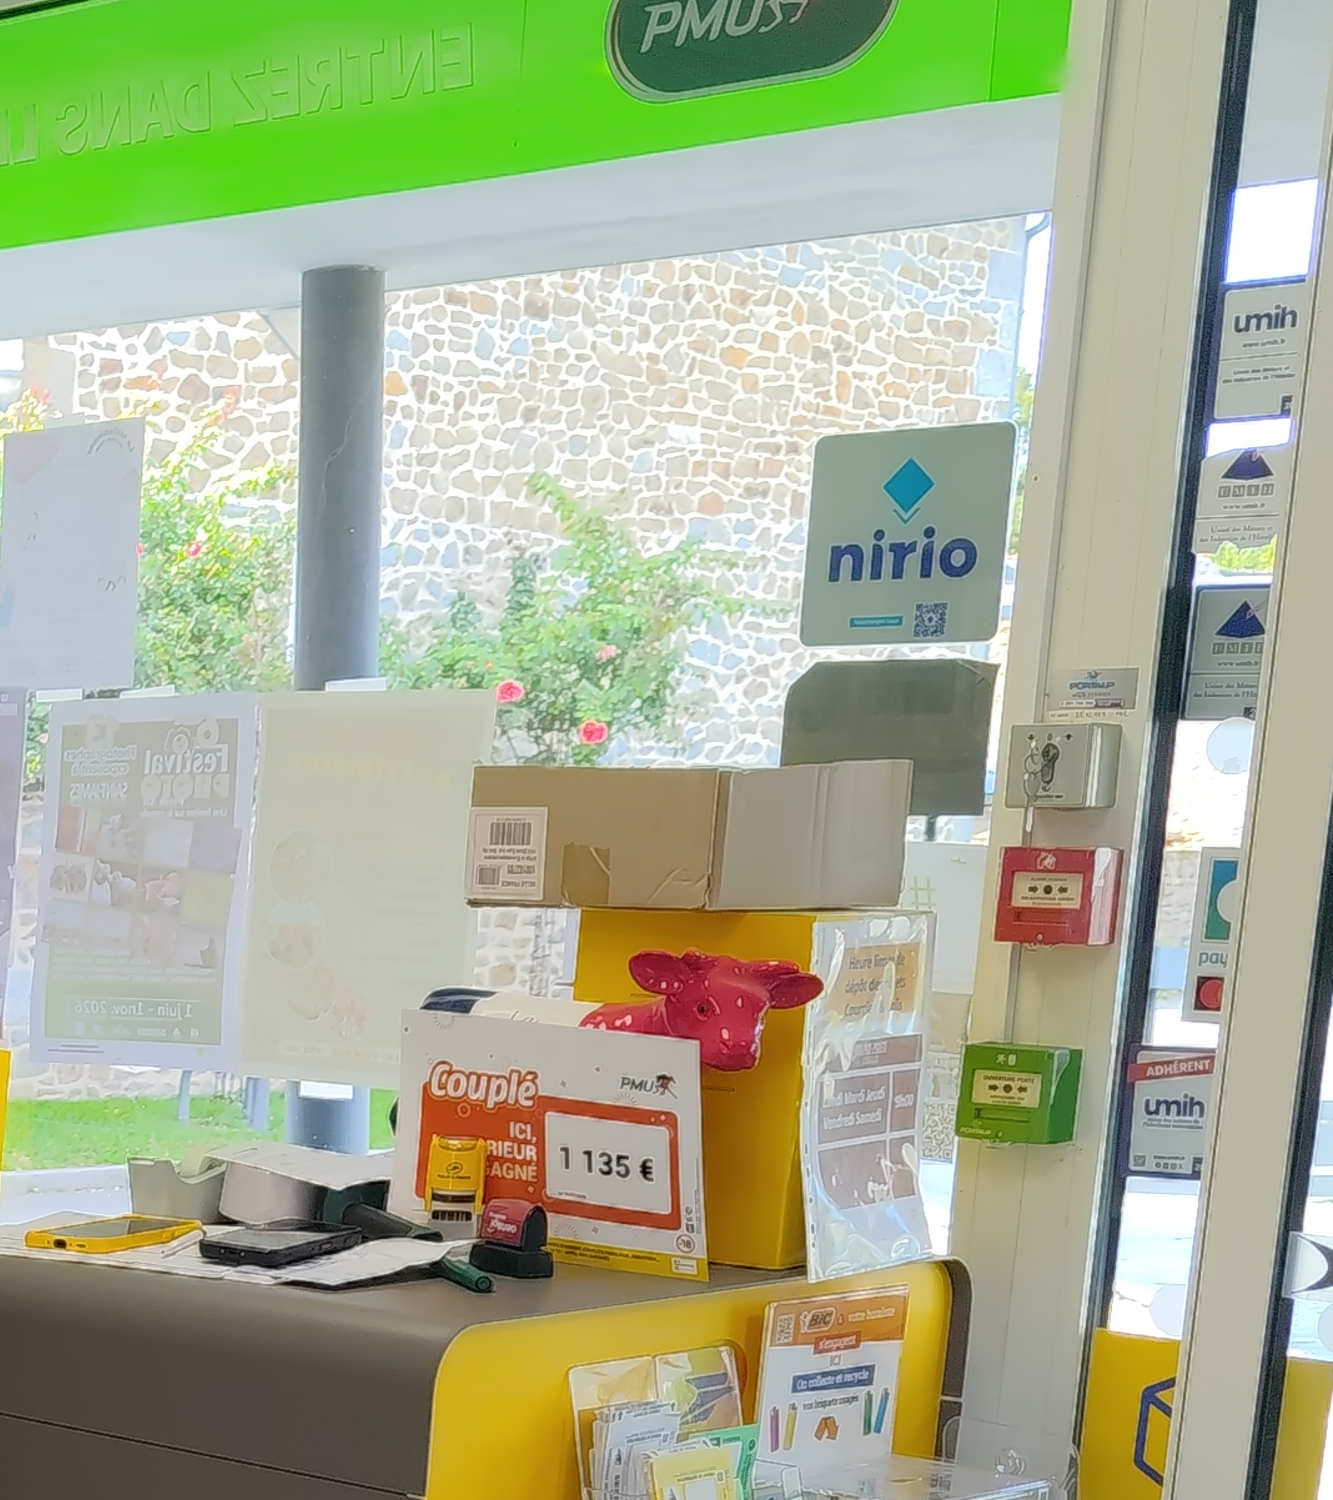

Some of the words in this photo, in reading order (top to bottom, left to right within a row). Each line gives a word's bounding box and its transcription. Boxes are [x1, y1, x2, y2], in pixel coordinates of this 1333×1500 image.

[640, 0, 764, 54] PMU
[1233, 303, 1299, 334] umih
[827, 527, 978, 584] nirio
[848, 957, 872, 970] Heure
[1197, 951, 1228, 968] pay
[844, 981, 867, 996] dépôt
[1145, 1058, 1212, 1077] ADHÉRENT
[430, 1063, 539, 1109] Couplé
[619, 1075, 653, 1094] PMU
[1144, 1092, 1205, 1119] umih
[508, 1121, 538, 1143] ICI,
[582, 1150, 631, 1178] 135
[638, 1157, 655, 1182] €
[808, 1313, 833, 1330] BIC
[844, 1369, 870, 1385] recycle
